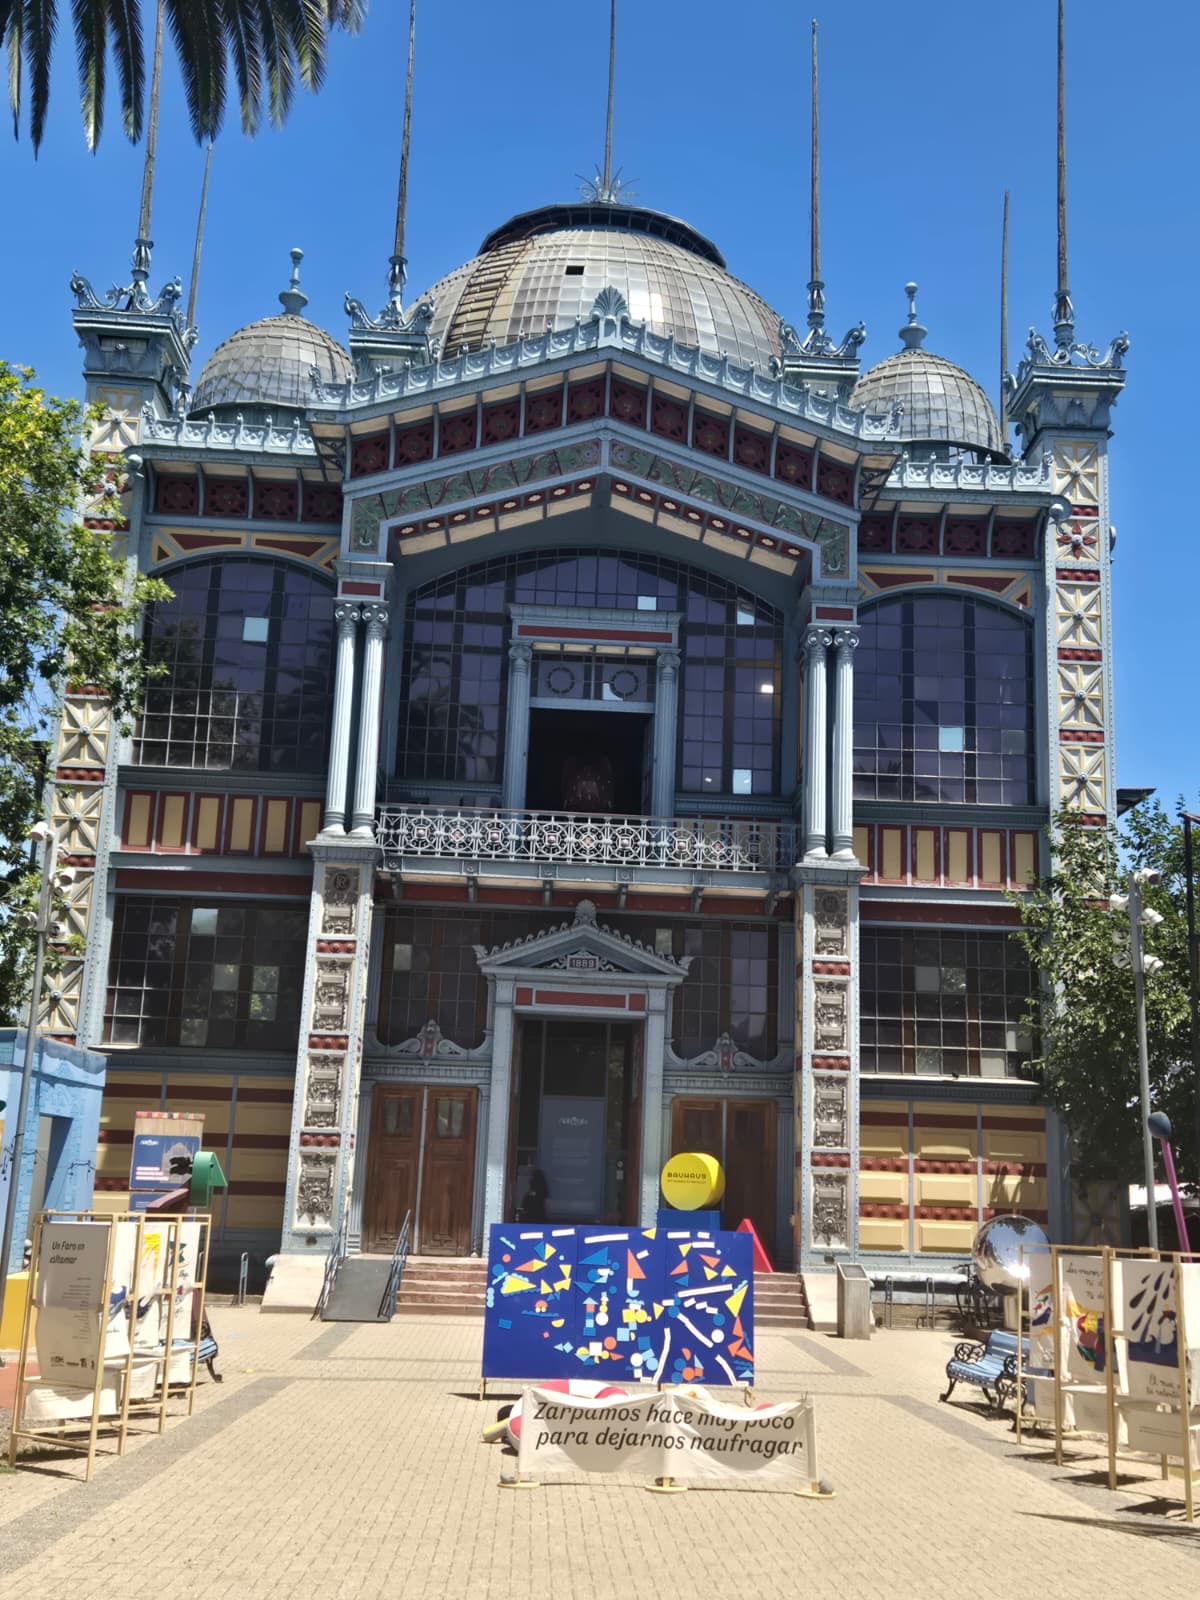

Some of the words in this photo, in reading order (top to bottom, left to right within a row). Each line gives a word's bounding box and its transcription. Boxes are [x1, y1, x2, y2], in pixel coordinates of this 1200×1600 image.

[573, 959, 594, 968] 1889
[533, 1402, 641, 1425] Zarpamos
[646, 1403, 693, 1424] hace
[697, 1412, 738, 1432] muy
[744, 1415, 795, 1432] poco
[535, 1431, 589, 1450] para
[595, 1427, 686, 1450] dejarnos
[690, 1433, 803, 1459] naufragar
